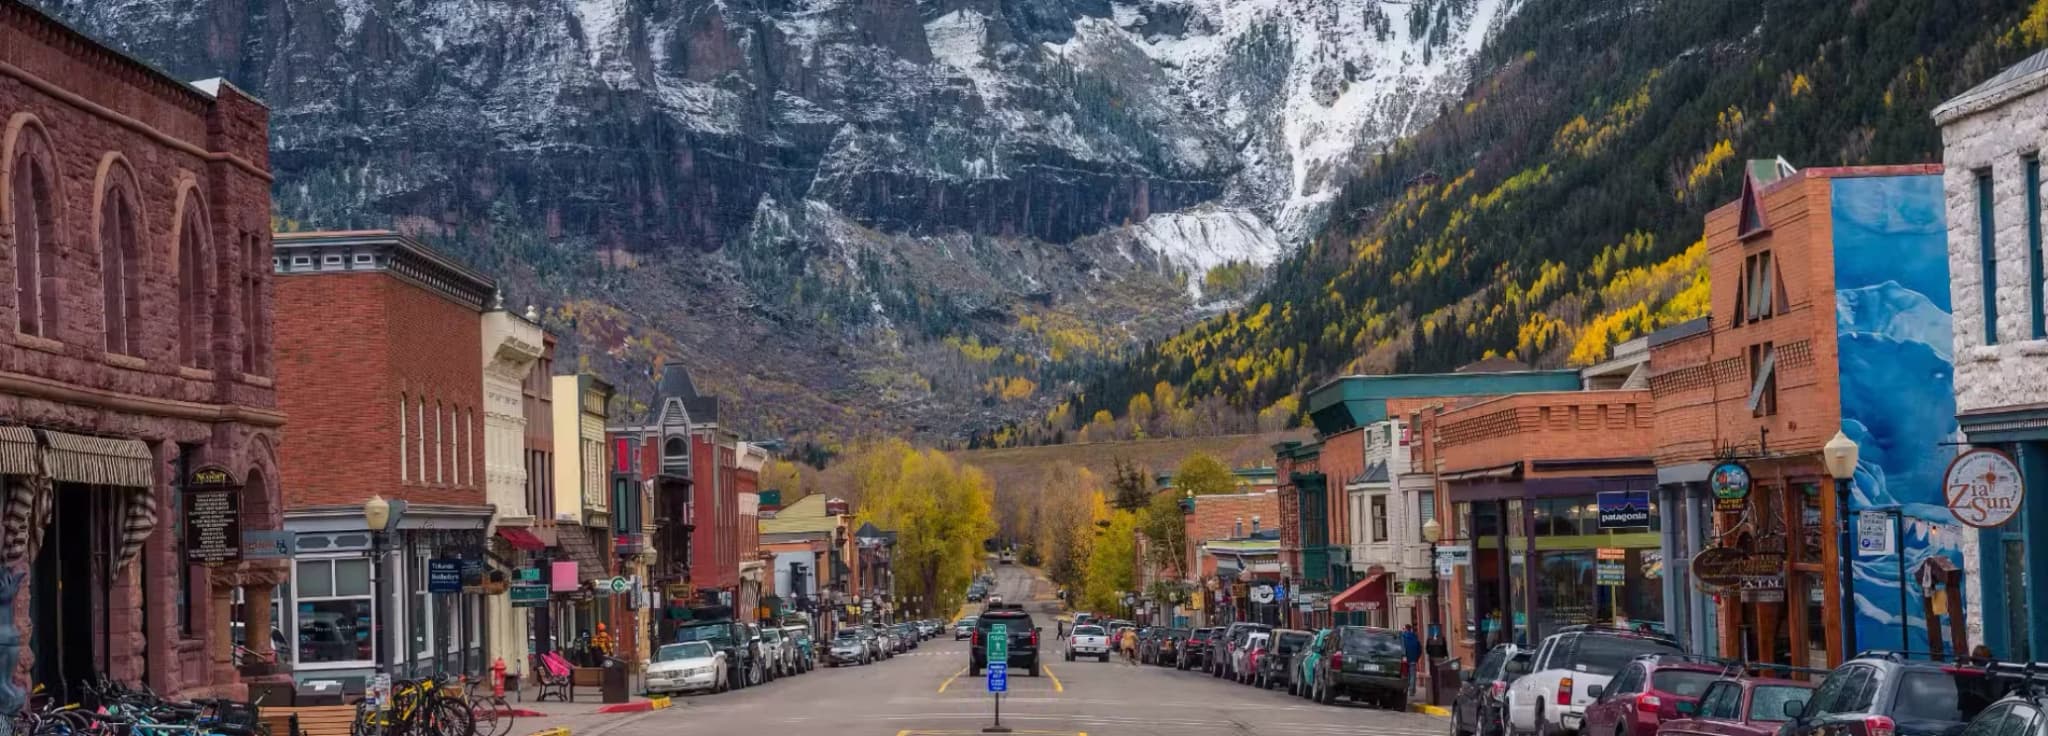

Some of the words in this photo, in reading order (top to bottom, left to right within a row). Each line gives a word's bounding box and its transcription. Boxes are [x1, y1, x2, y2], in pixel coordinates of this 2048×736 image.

[1949, 480, 1989, 509] Zia
[1602, 512, 1647, 522] patagonia
[1971, 497, 2011, 521] Sun
